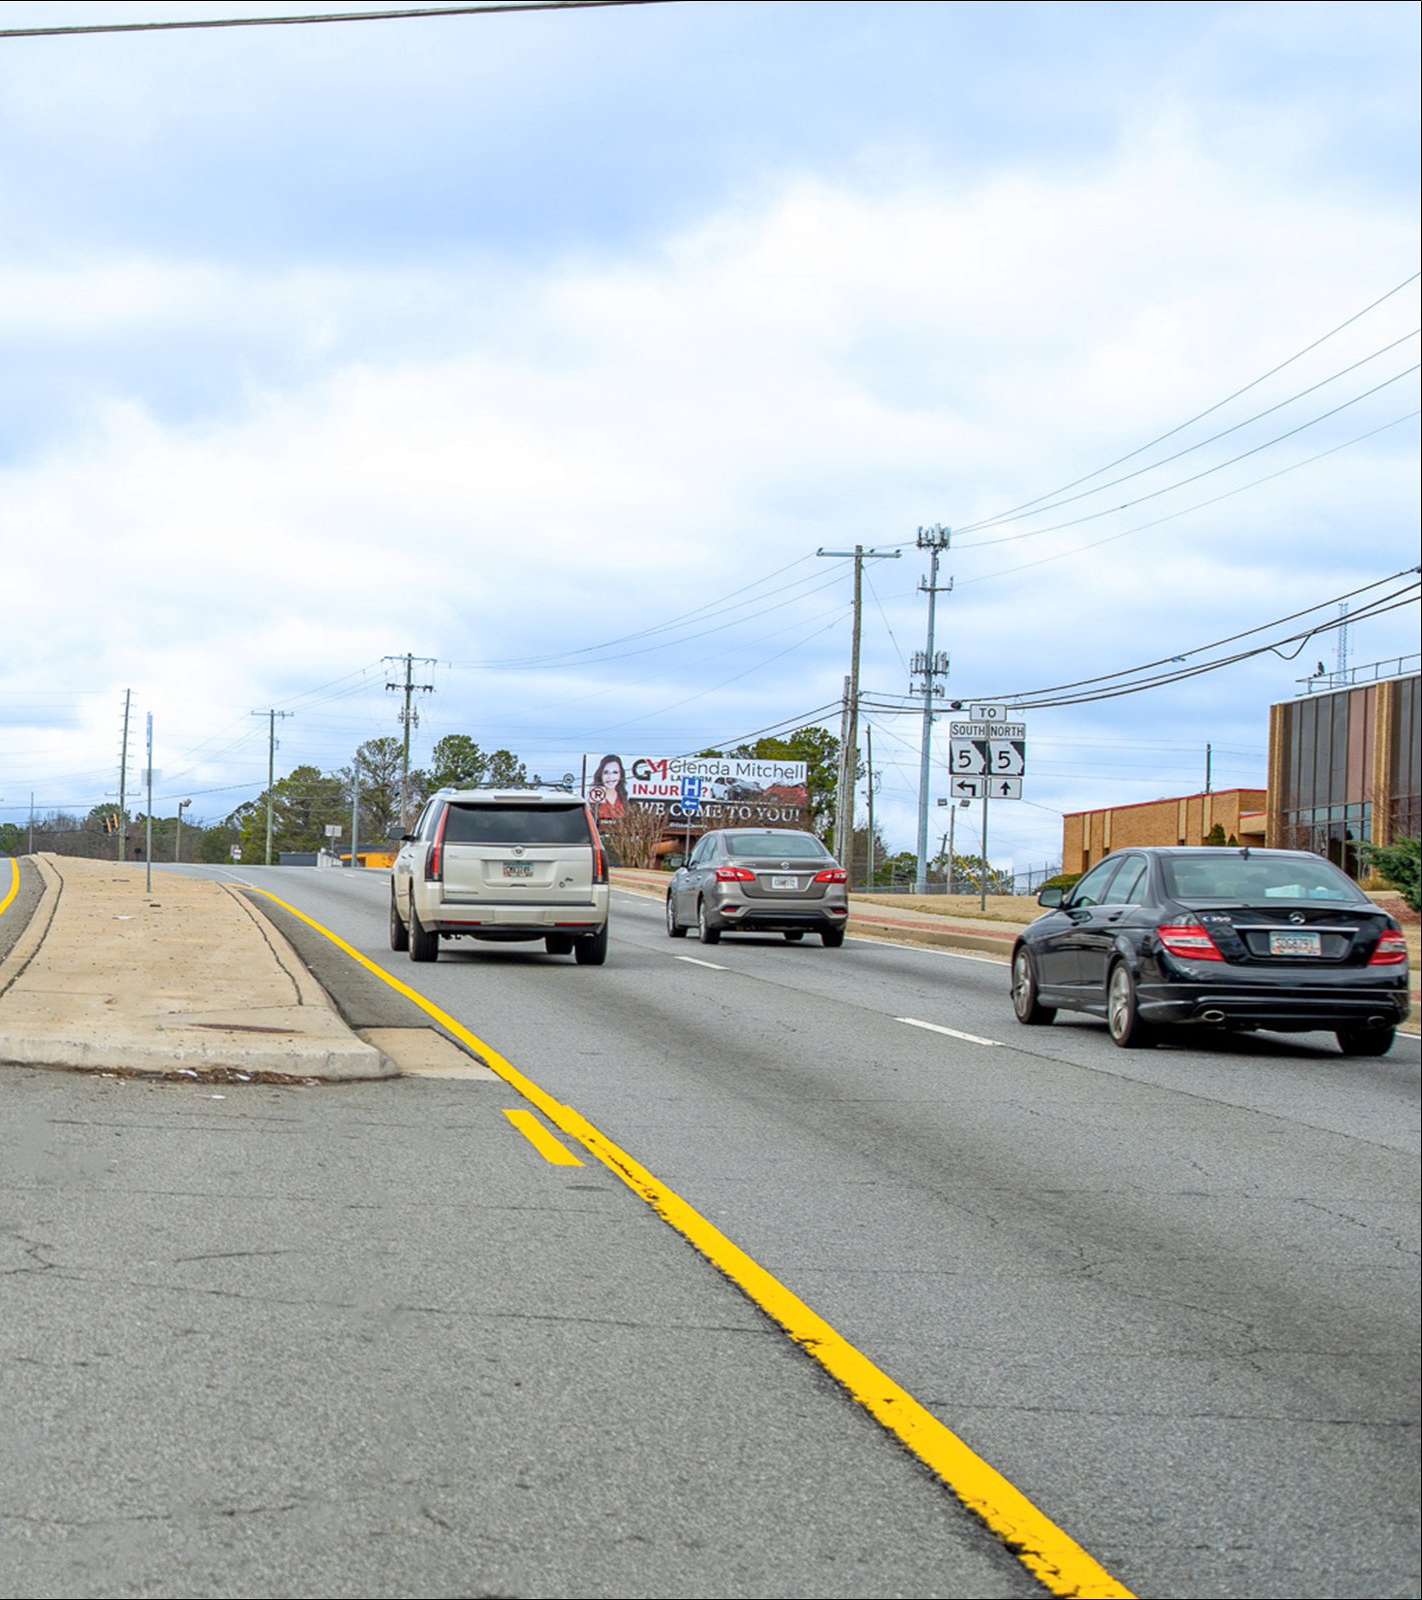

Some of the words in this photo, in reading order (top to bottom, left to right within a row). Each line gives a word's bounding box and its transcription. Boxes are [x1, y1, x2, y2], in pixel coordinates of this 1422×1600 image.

[979, 707, 997, 718] TO
[952, 724, 986, 736] SOUTH
[990, 725, 1024, 737] NORTH
[958, 749, 972, 769] 5
[998, 750, 1011, 769] 5
[669, 760, 730, 776] Glenda
[736, 763, 804, 779] Mitchell
[683, 778, 699, 797] H
[638, 801, 666, 816] WE
[727, 805, 752, 820] TO
[756, 807, 800, 822] YOU!
